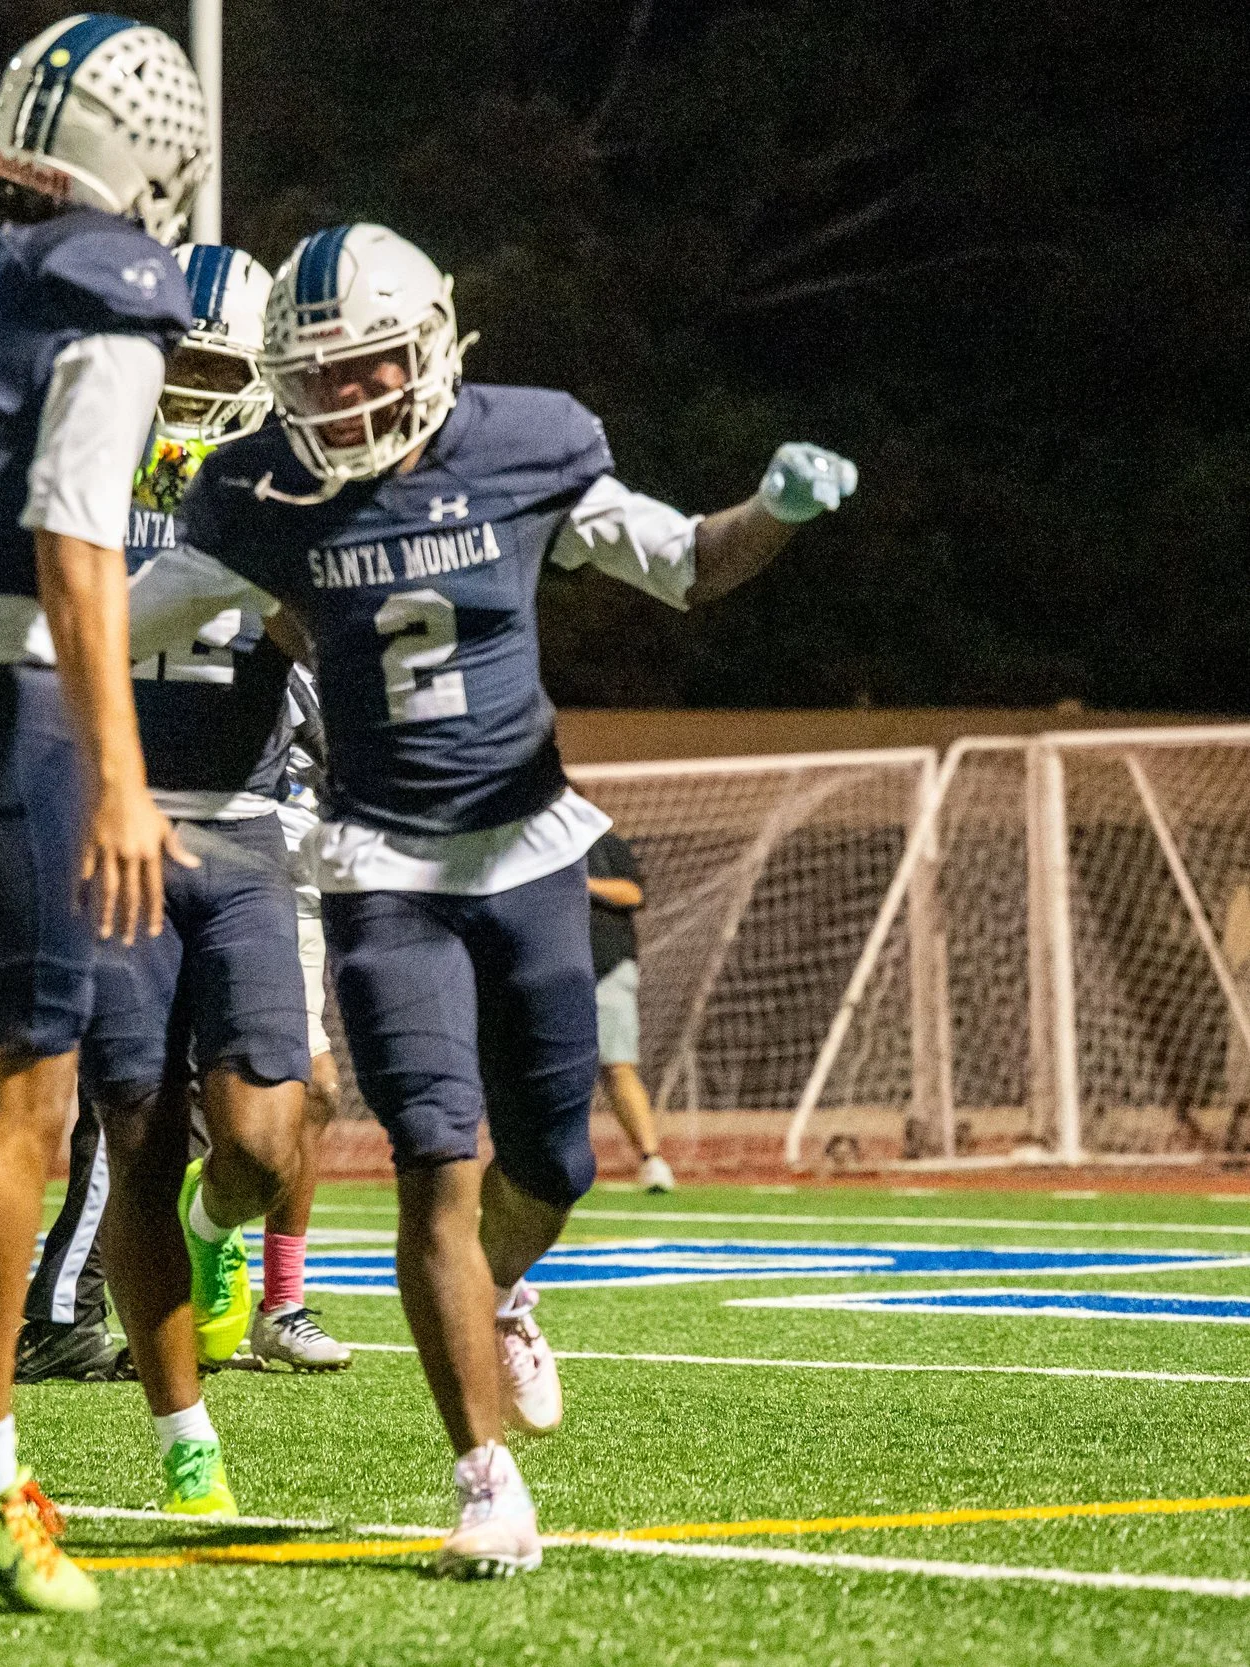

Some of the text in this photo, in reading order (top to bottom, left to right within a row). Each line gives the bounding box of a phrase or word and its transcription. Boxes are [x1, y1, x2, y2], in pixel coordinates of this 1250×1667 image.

[307, 521, 502, 589] SANTA MONICA
[373, 588, 468, 723] 2
